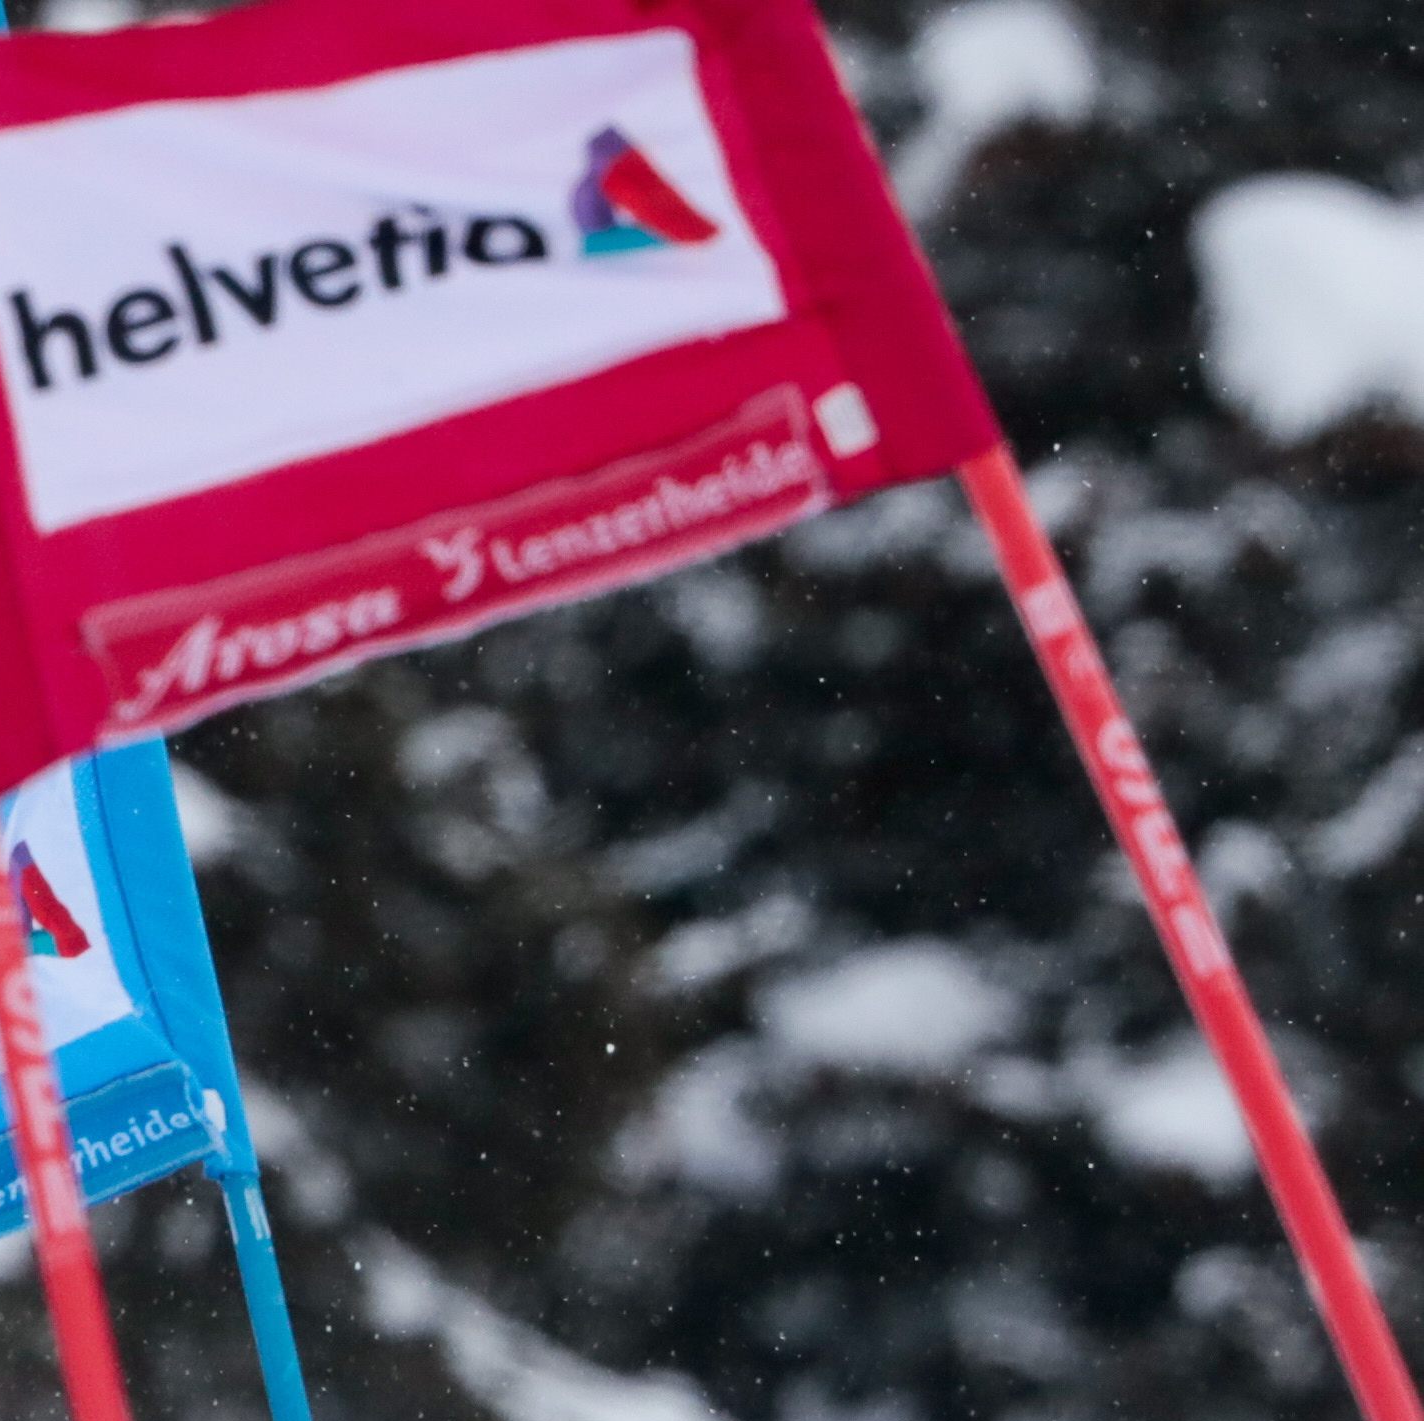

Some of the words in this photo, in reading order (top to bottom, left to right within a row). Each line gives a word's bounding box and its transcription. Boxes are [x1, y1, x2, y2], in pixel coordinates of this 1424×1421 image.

[8, 203, 548, 391] helvetia
[111, 589, 401, 722] Arosa
[490, 441, 810, 582] Lenzerheide
